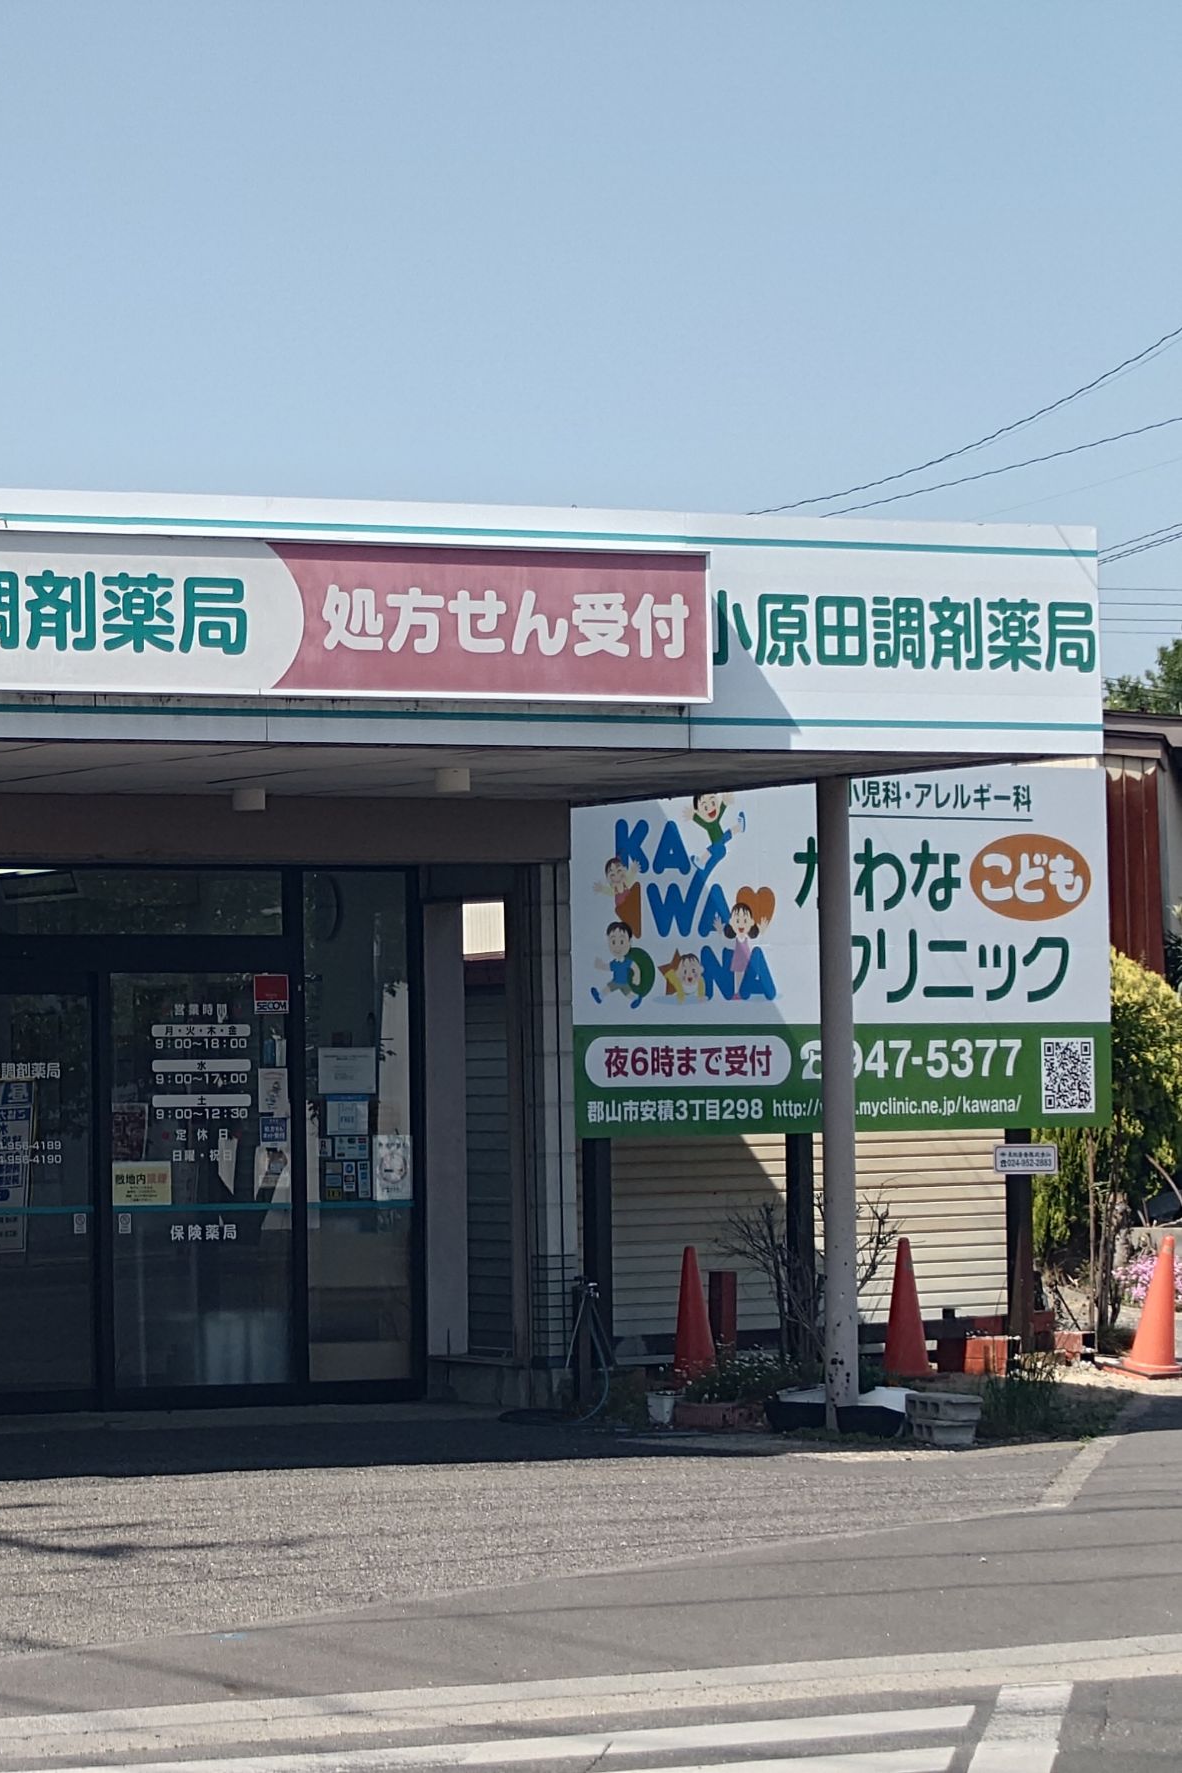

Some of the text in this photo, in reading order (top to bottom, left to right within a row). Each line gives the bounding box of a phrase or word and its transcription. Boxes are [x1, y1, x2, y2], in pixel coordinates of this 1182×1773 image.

[321, 582, 689, 661] 処方せん受付
[980, 852, 1083, 904] こども
[174, 1003, 228, 1016] 営業時間
[257, 1001, 287, 1011] SECOM
[165, 1025, 237, 1036] 月・火・木・金
[197, 1061, 206, 1071] 水
[604, 1045, 772, 1078] 夜6時まで受付
[197, 1096, 206, 1105] 土
[587, 1095, 1022, 1123] 郡山市安積3丁目298 http://.myclinic.ne.jp/kawana/
[175, 1129, 229, 1141] 定休日
[172, 1150, 233, 1162] 日曜・祝日
[170, 1224, 237, 1240] 保険薬局
